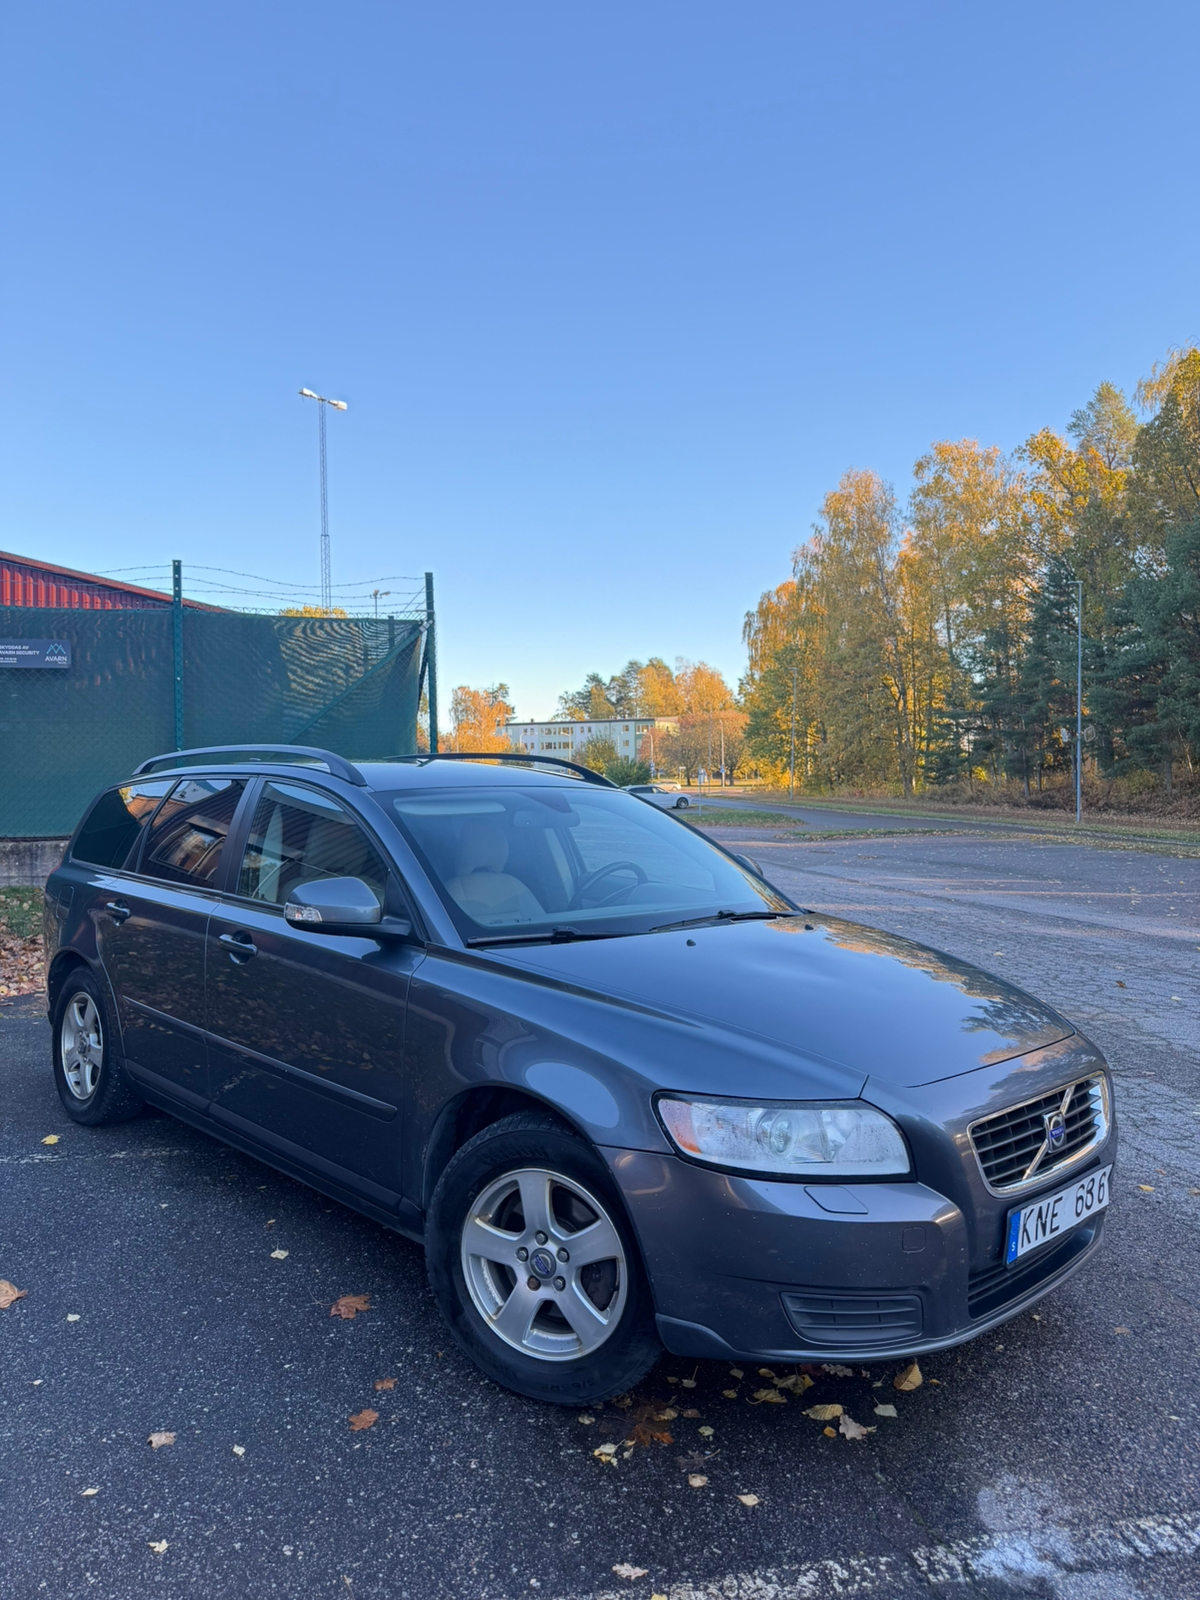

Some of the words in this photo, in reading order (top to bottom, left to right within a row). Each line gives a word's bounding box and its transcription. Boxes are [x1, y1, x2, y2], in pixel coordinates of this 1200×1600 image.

[1021, 1196, 1063, 1249] KNE
[1075, 1171, 1107, 1218] 686
[1011, 1242, 1016, 1252] S
